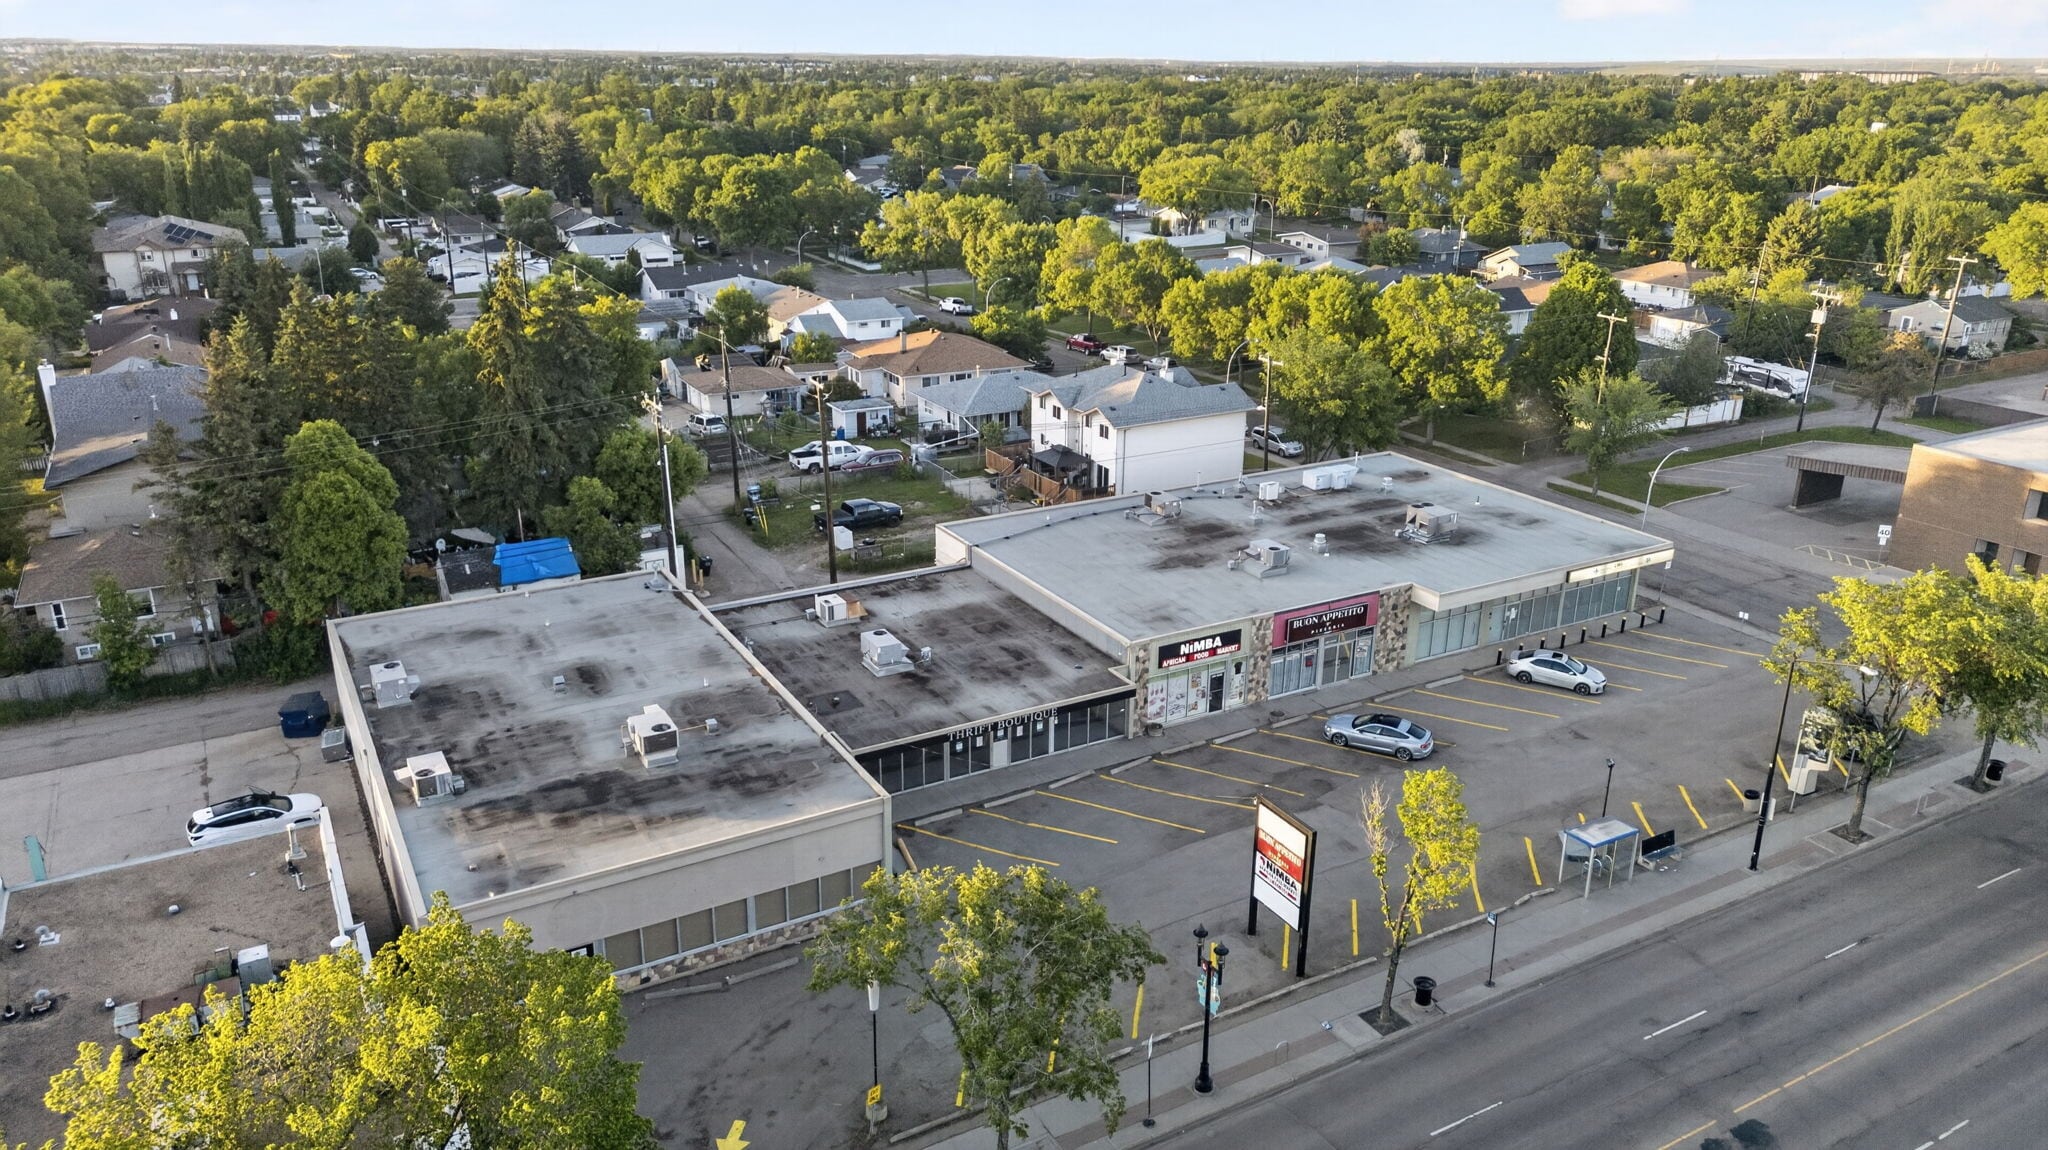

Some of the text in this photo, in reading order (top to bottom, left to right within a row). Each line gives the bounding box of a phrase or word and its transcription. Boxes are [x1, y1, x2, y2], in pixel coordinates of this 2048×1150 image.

[1292, 606, 1364, 629] BUON APPETITO
[1162, 644, 1239, 668] AFRICAN FOOD MARKET
[948, 707, 1058, 741] THRIFT BOUTIQUE
